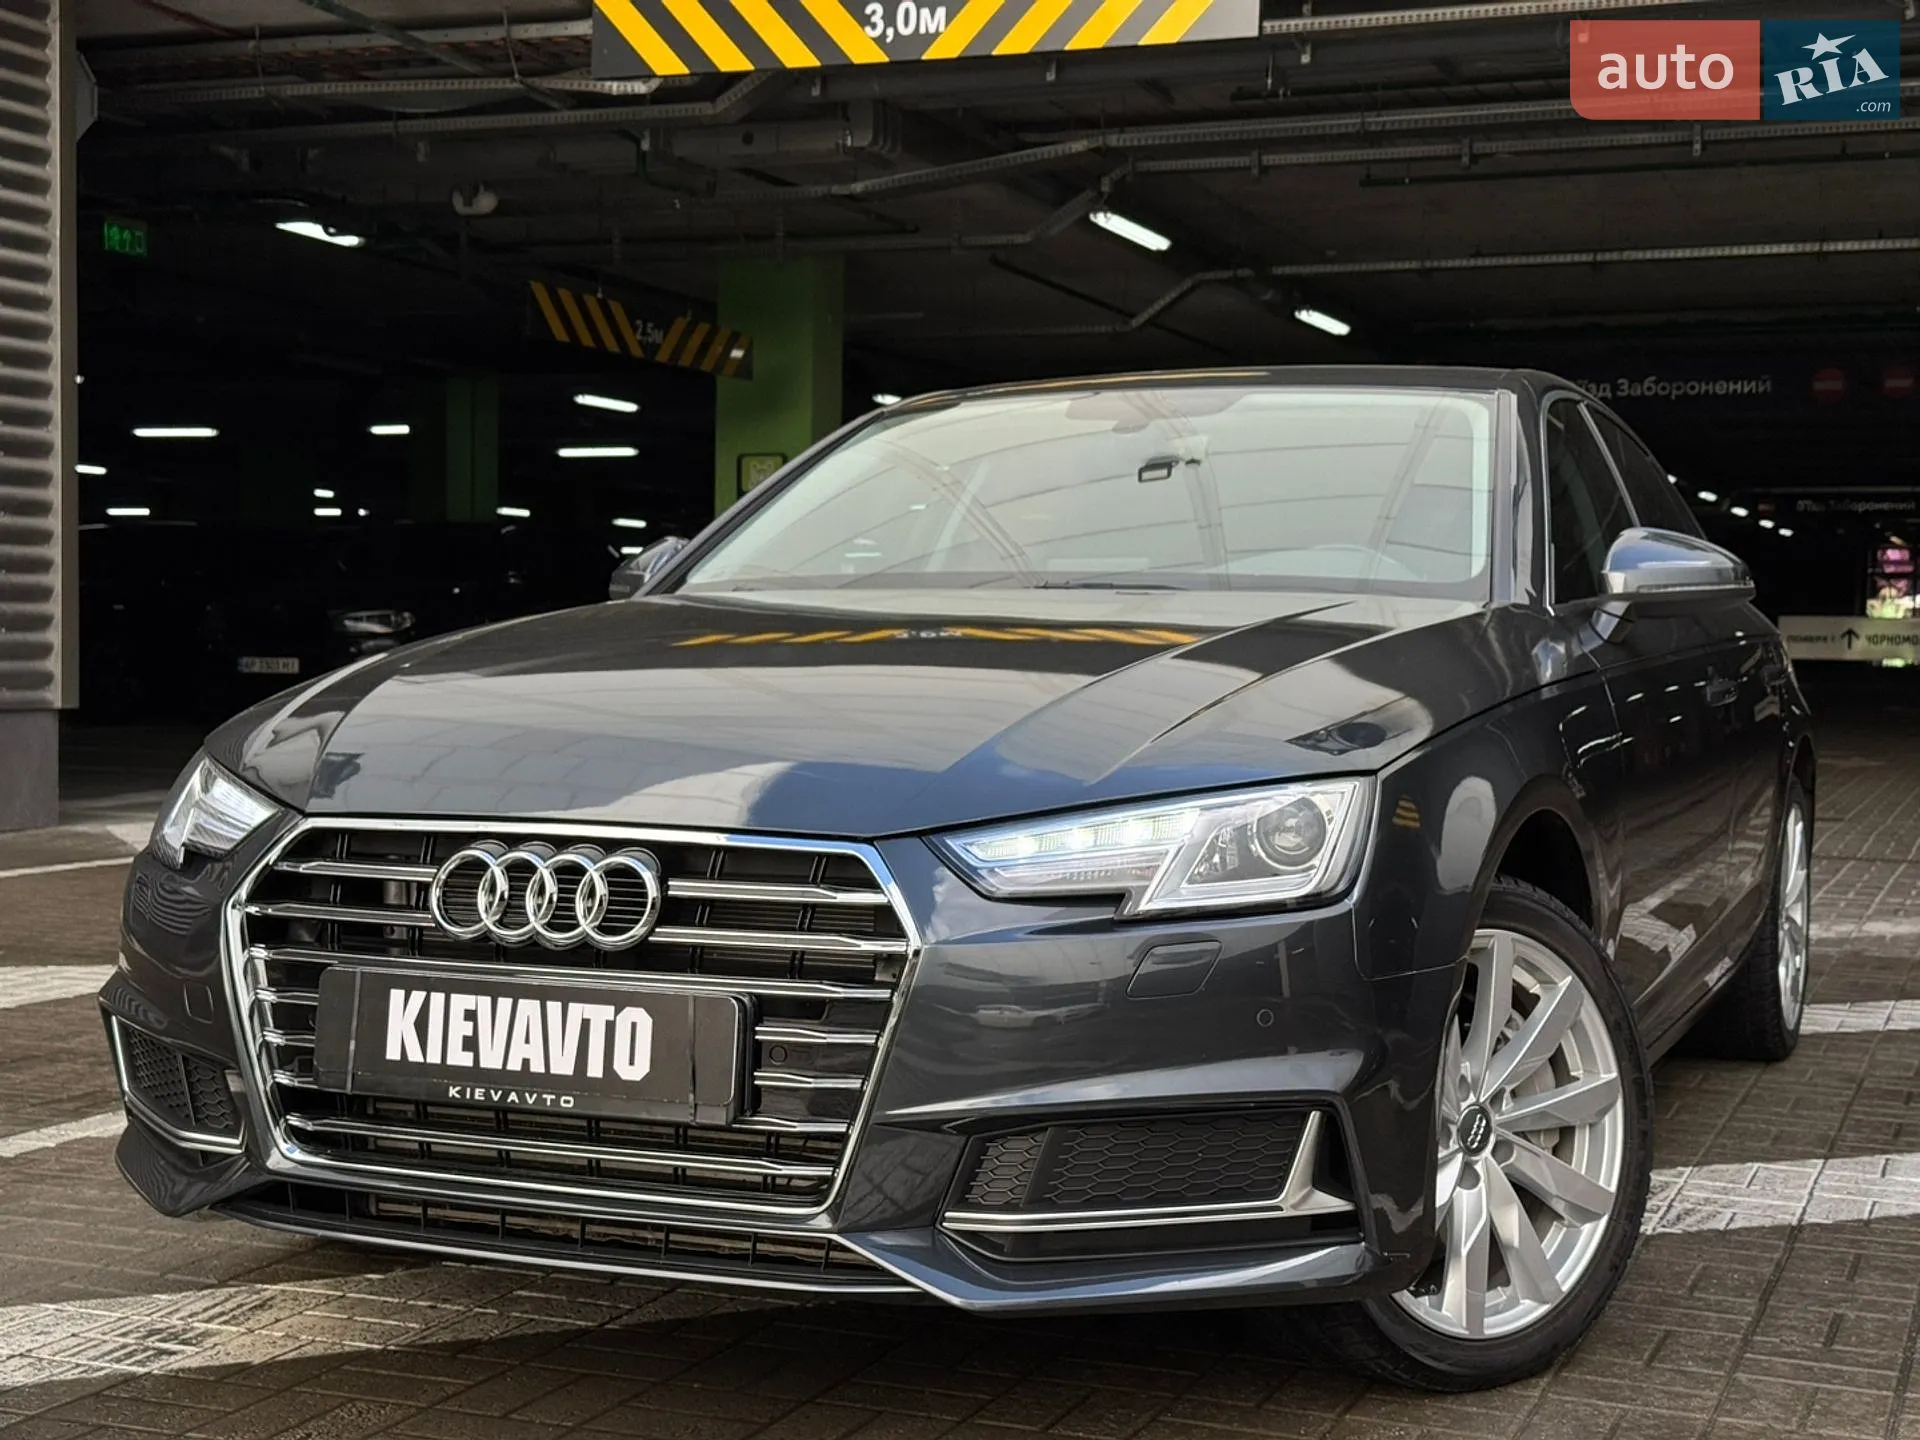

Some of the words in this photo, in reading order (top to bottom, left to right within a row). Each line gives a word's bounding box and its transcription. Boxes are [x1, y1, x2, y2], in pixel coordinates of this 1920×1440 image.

[864, 0, 947, 43] 3,0м
[1615, 375, 1772, 400] Заборонений
[386, 988, 653, 1081] KIEVAVTO
[449, 1085, 575, 1108] KIEVAVTO
